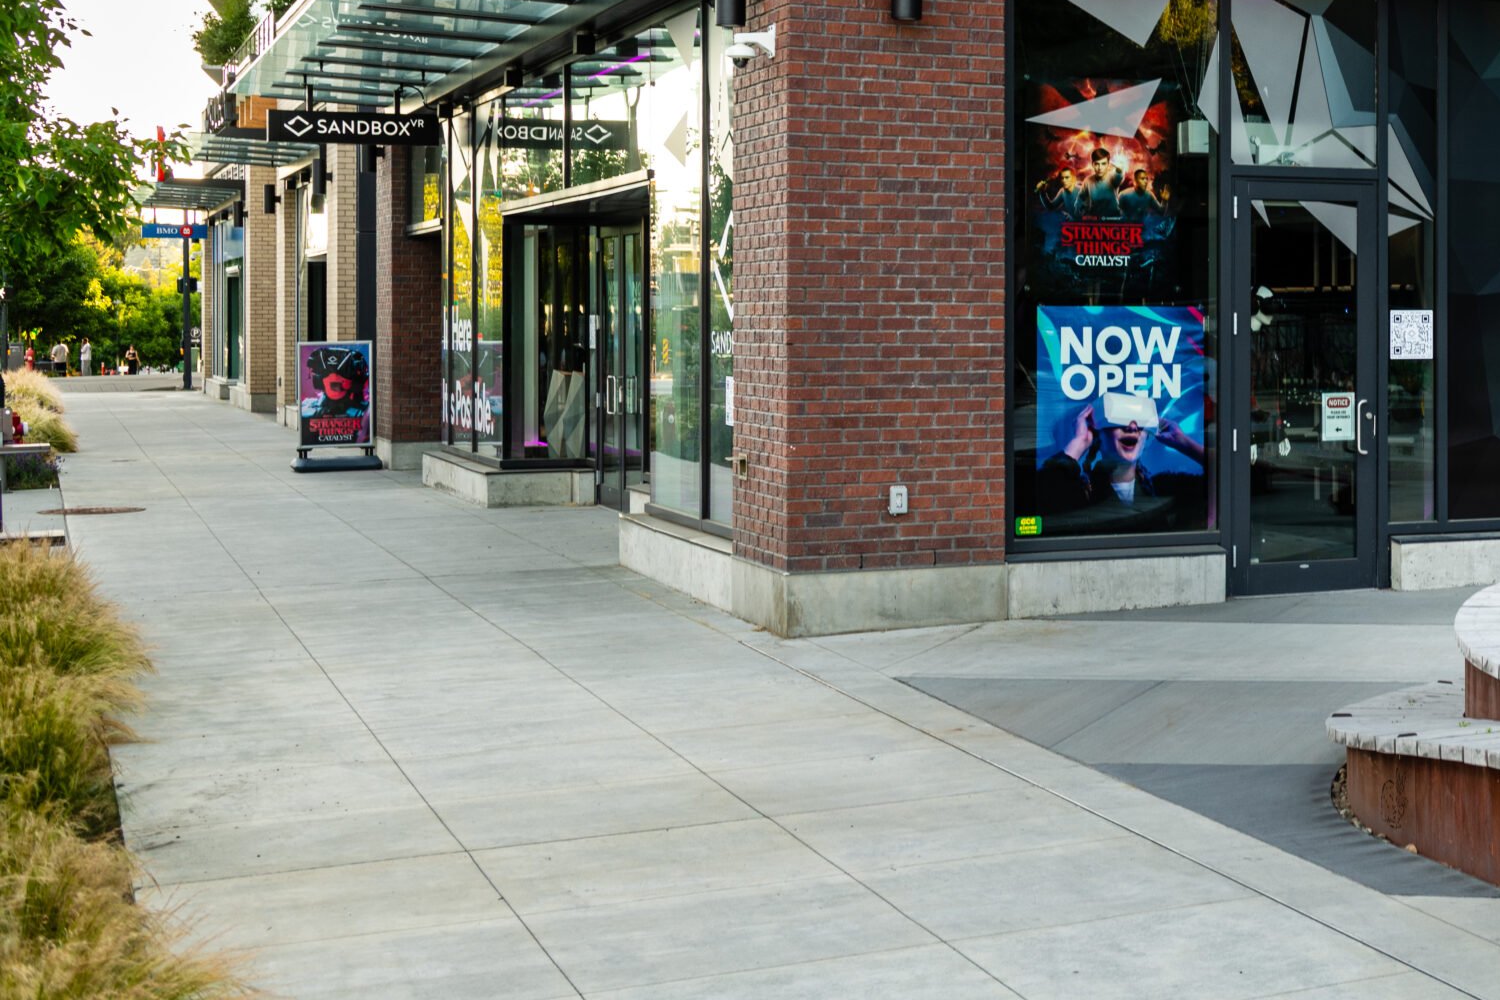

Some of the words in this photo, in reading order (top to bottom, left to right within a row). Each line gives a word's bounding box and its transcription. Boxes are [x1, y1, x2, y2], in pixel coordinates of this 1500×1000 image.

[316, 118, 411, 137] SANDBOX
[409, 118, 425, 128] VR
[156, 226, 178, 235] BMO
[1061, 223, 1143, 246] STRANGER
[1075, 241, 1132, 255] THINGS
[1075, 255, 1131, 266] CATALYST
[1060, 325, 1182, 365] NOW
[1060, 363, 1182, 401] OPEN
[455, 379, 494, 436] Posible.
[1328, 399, 1348, 407] NOTICE
[309, 418, 361, 431] STRANGER
